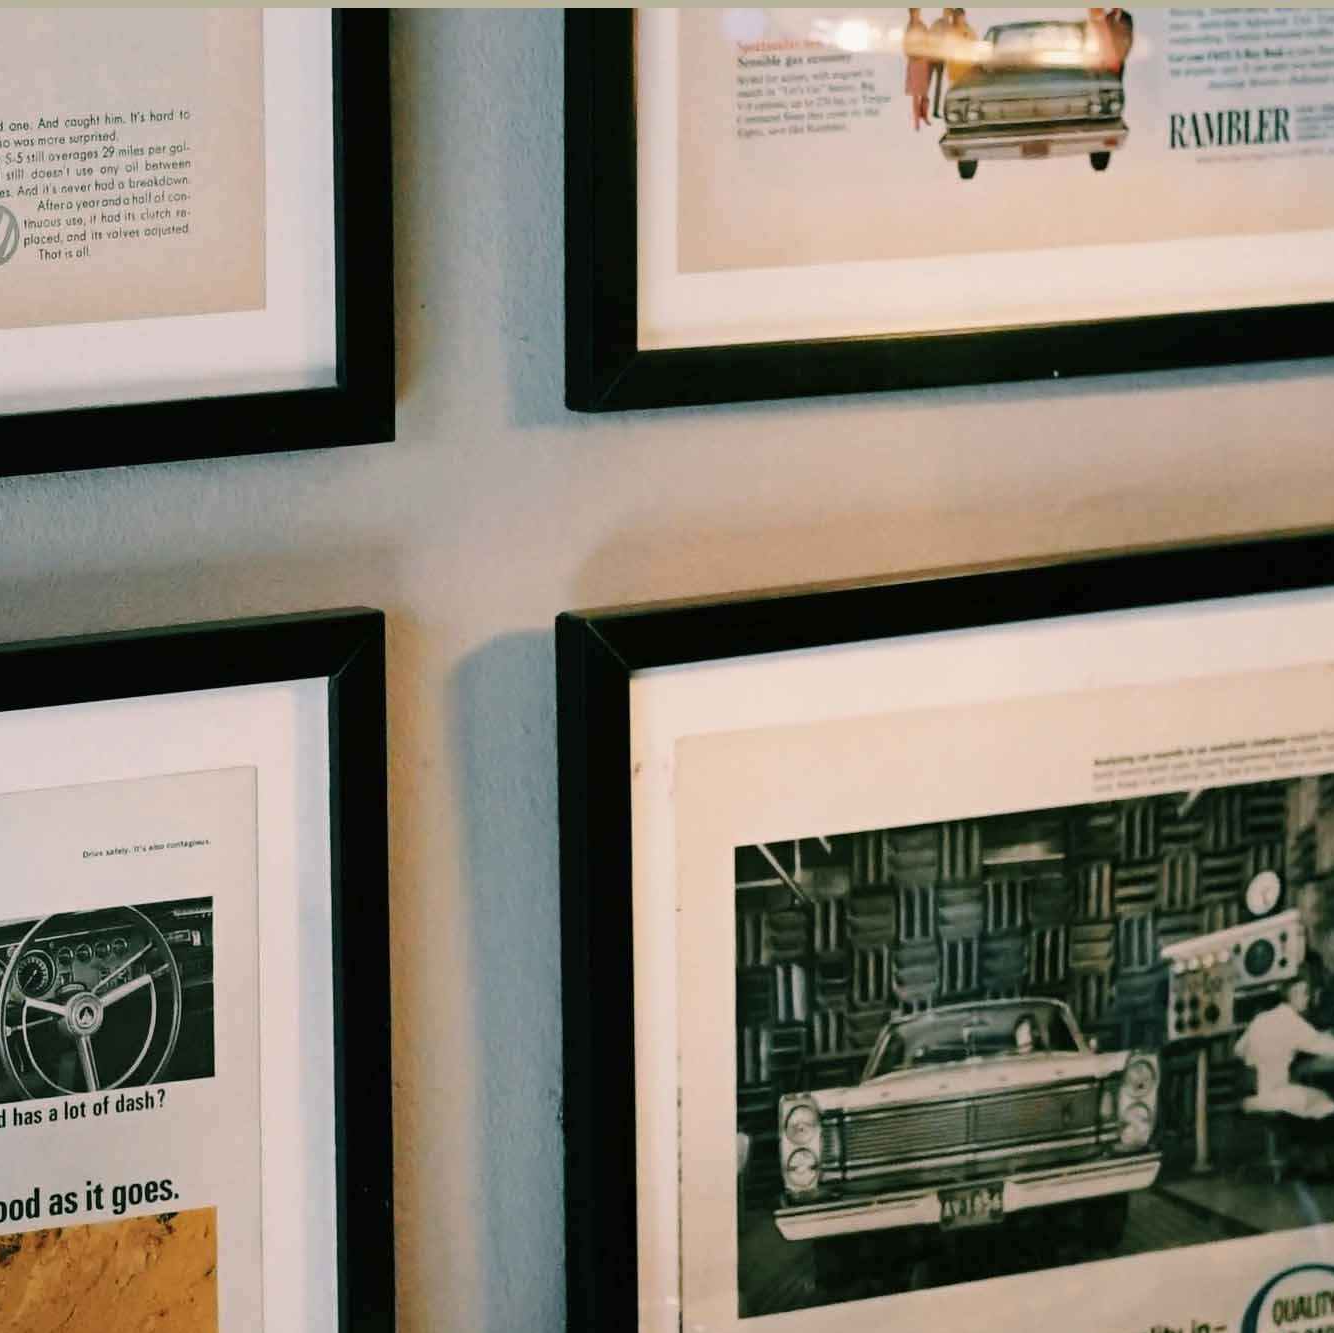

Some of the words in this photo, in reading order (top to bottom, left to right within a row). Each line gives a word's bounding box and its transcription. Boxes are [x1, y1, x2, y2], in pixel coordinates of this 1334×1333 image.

[1169, 107, 1290, 150] RAMBLER
[13, 1106, 42, 1126] has
[48, 1107, 58, 1122] a
[64, 1100, 86, 1120] lot
[92, 1095, 109, 1116] of
[115, 1088, 165, 1113] dash?
[48, 1190, 78, 1216] as
[86, 1181, 104, 1211] it
[112, 1178, 180, 1215] goes.
